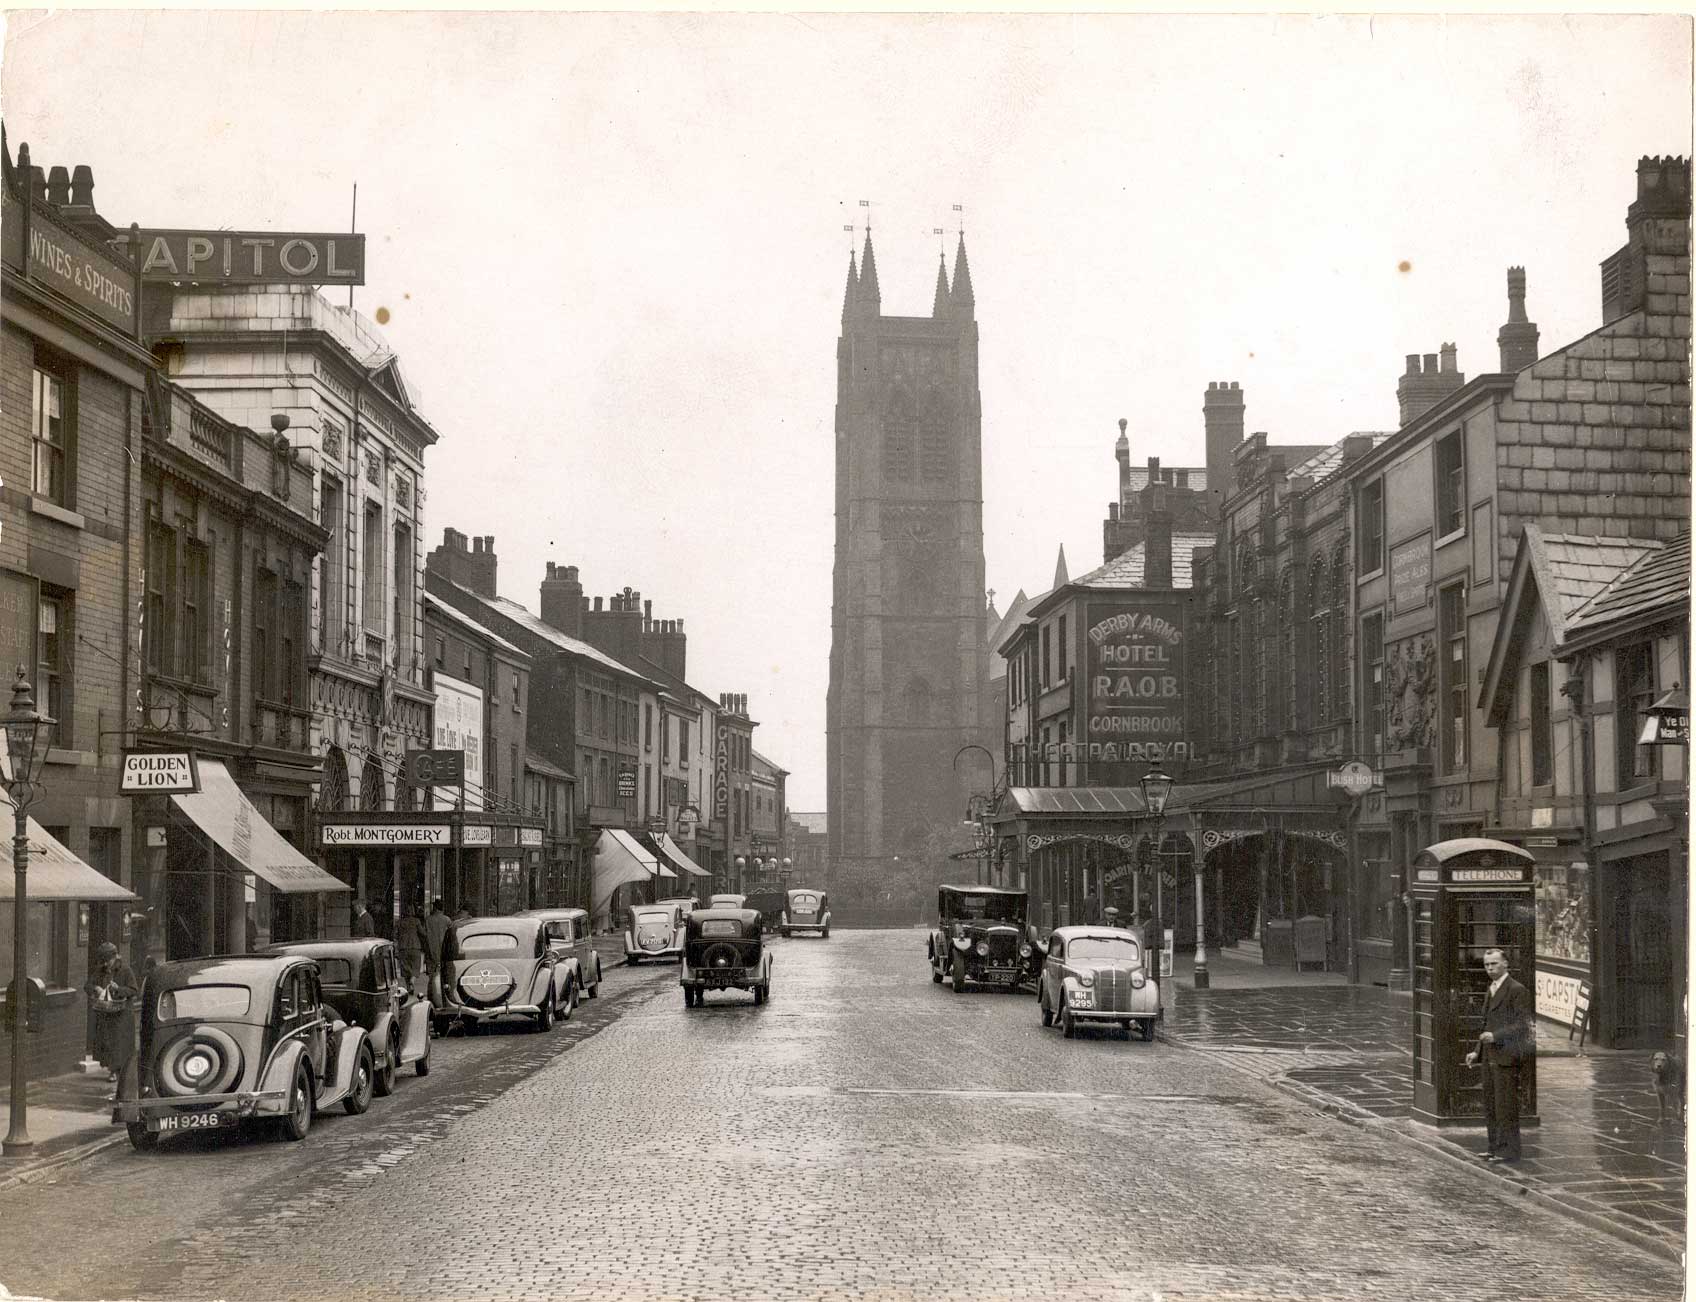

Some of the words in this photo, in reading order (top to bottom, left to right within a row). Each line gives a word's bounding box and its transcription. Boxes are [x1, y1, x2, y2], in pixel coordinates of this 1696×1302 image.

[142, 236, 357, 277] APITOL
[30, 226, 72, 279] WINES
[74, 266, 82, 287] &
[84, 263, 132, 316] SPIRITS
[1088, 612, 1140, 646] DERBY
[1140, 614, 1183, 645] ARMS
[1103, 645, 1169, 663] HOTEL
[1090, 716, 1183, 733] CORNBROOK
[127, 757, 187, 771] GOLDEN
[716, 725, 728, 818] GARAGE
[137, 772, 178, 786] LION
[1331, 775, 1354, 785] BUSH
[1356, 774, 1383, 785] HOTEL
[354, 827, 442, 842] MONTGOMERY
[1455, 869, 1520, 880] TELEPHONE
[1075, 991, 1087, 1000] WH
[1070, 1000, 1092, 1008] 9295
[160, 1116, 178, 1130] WH
[181, 1114, 218, 1128] 9246
